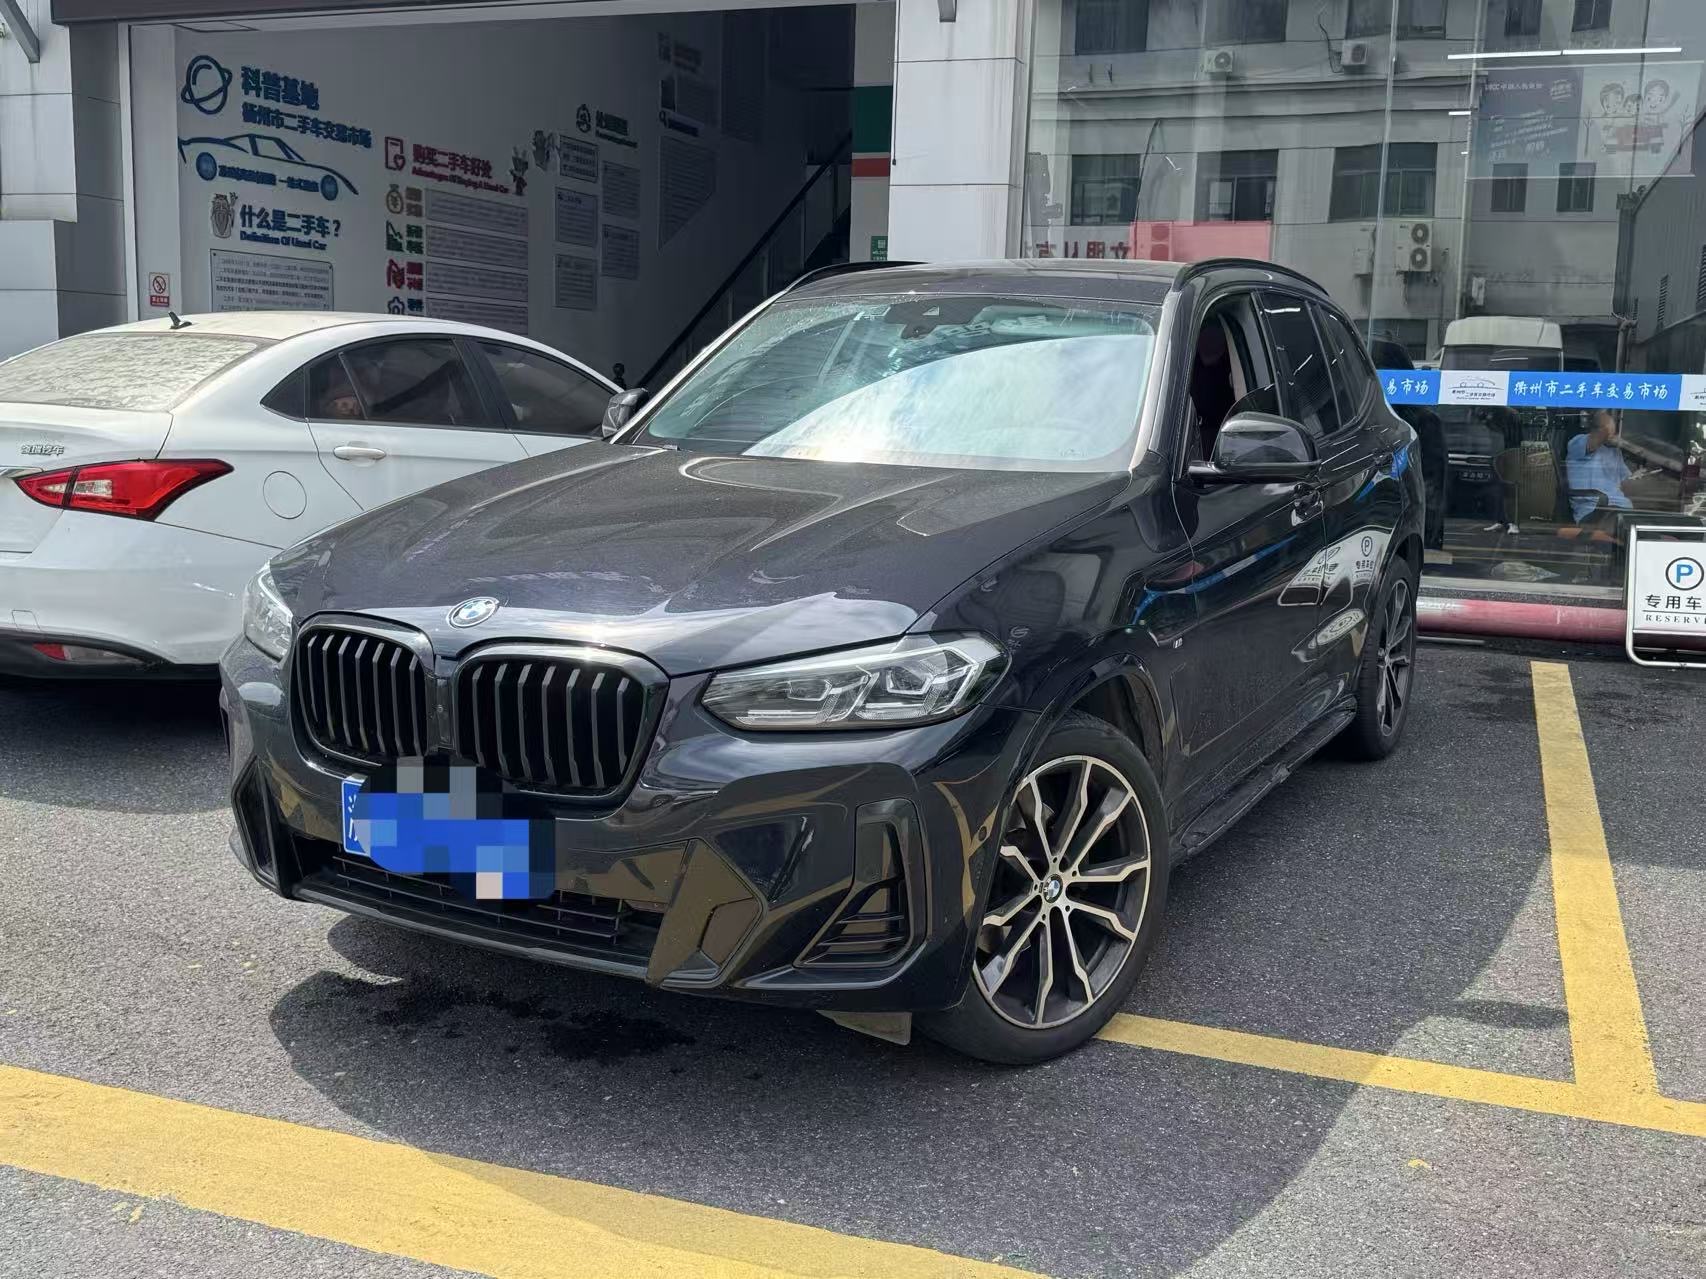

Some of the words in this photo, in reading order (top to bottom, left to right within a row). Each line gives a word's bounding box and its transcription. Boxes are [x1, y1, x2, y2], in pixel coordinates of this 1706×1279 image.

[1386, 378, 1429, 396] 易市场
[1513, 379, 1669, 399] 衢州市二手车交易市场
[1676, 564, 1694, 583] P
[1645, 594, 1702, 611] 专用车
